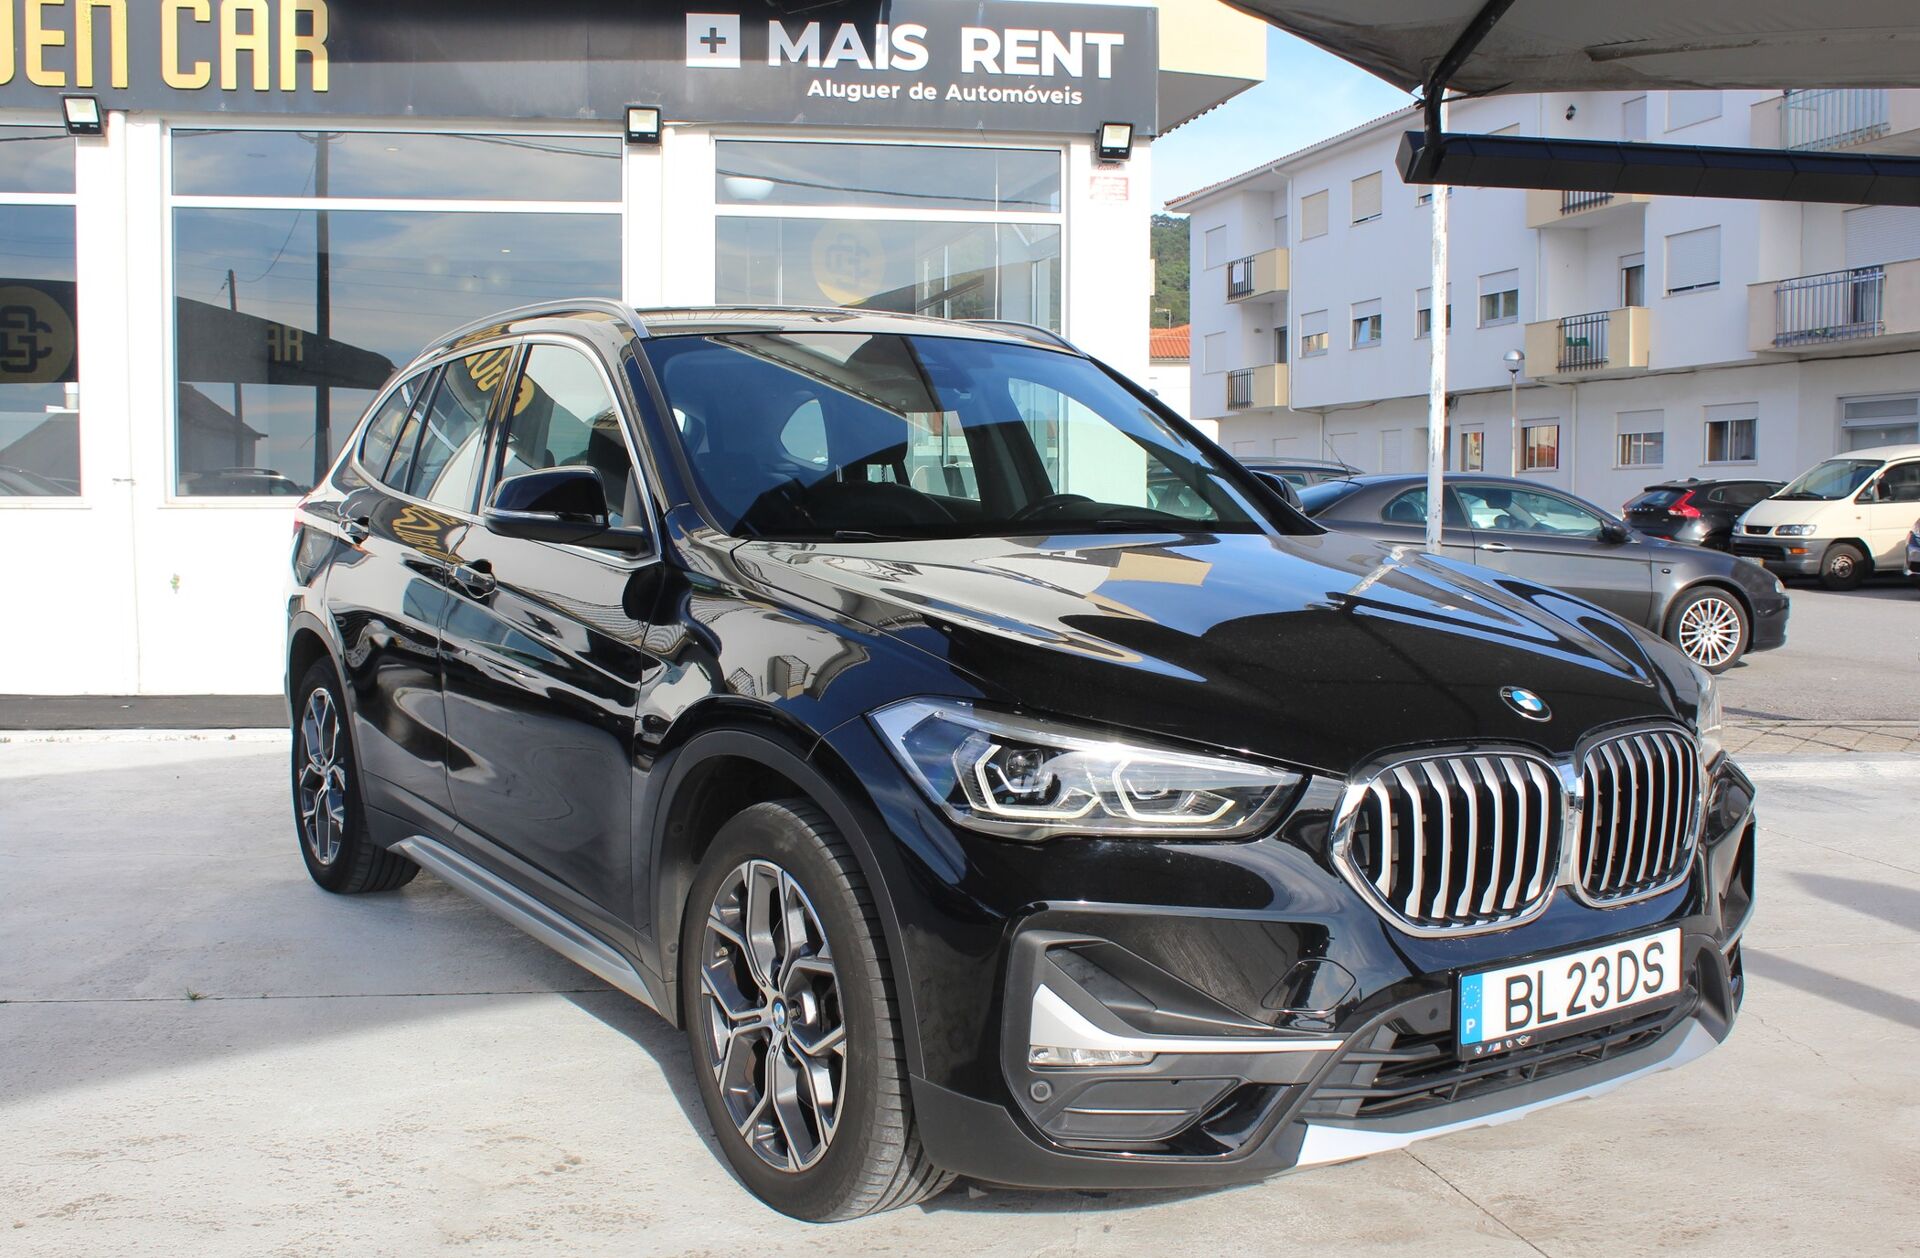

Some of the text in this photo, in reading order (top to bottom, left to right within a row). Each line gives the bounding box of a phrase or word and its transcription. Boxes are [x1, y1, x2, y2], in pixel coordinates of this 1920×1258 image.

[161, 0, 329, 92] CAR
[768, 20, 1125, 79] MAIS RENT
[807, 79, 1083, 106] Aluguer de Automóveis
